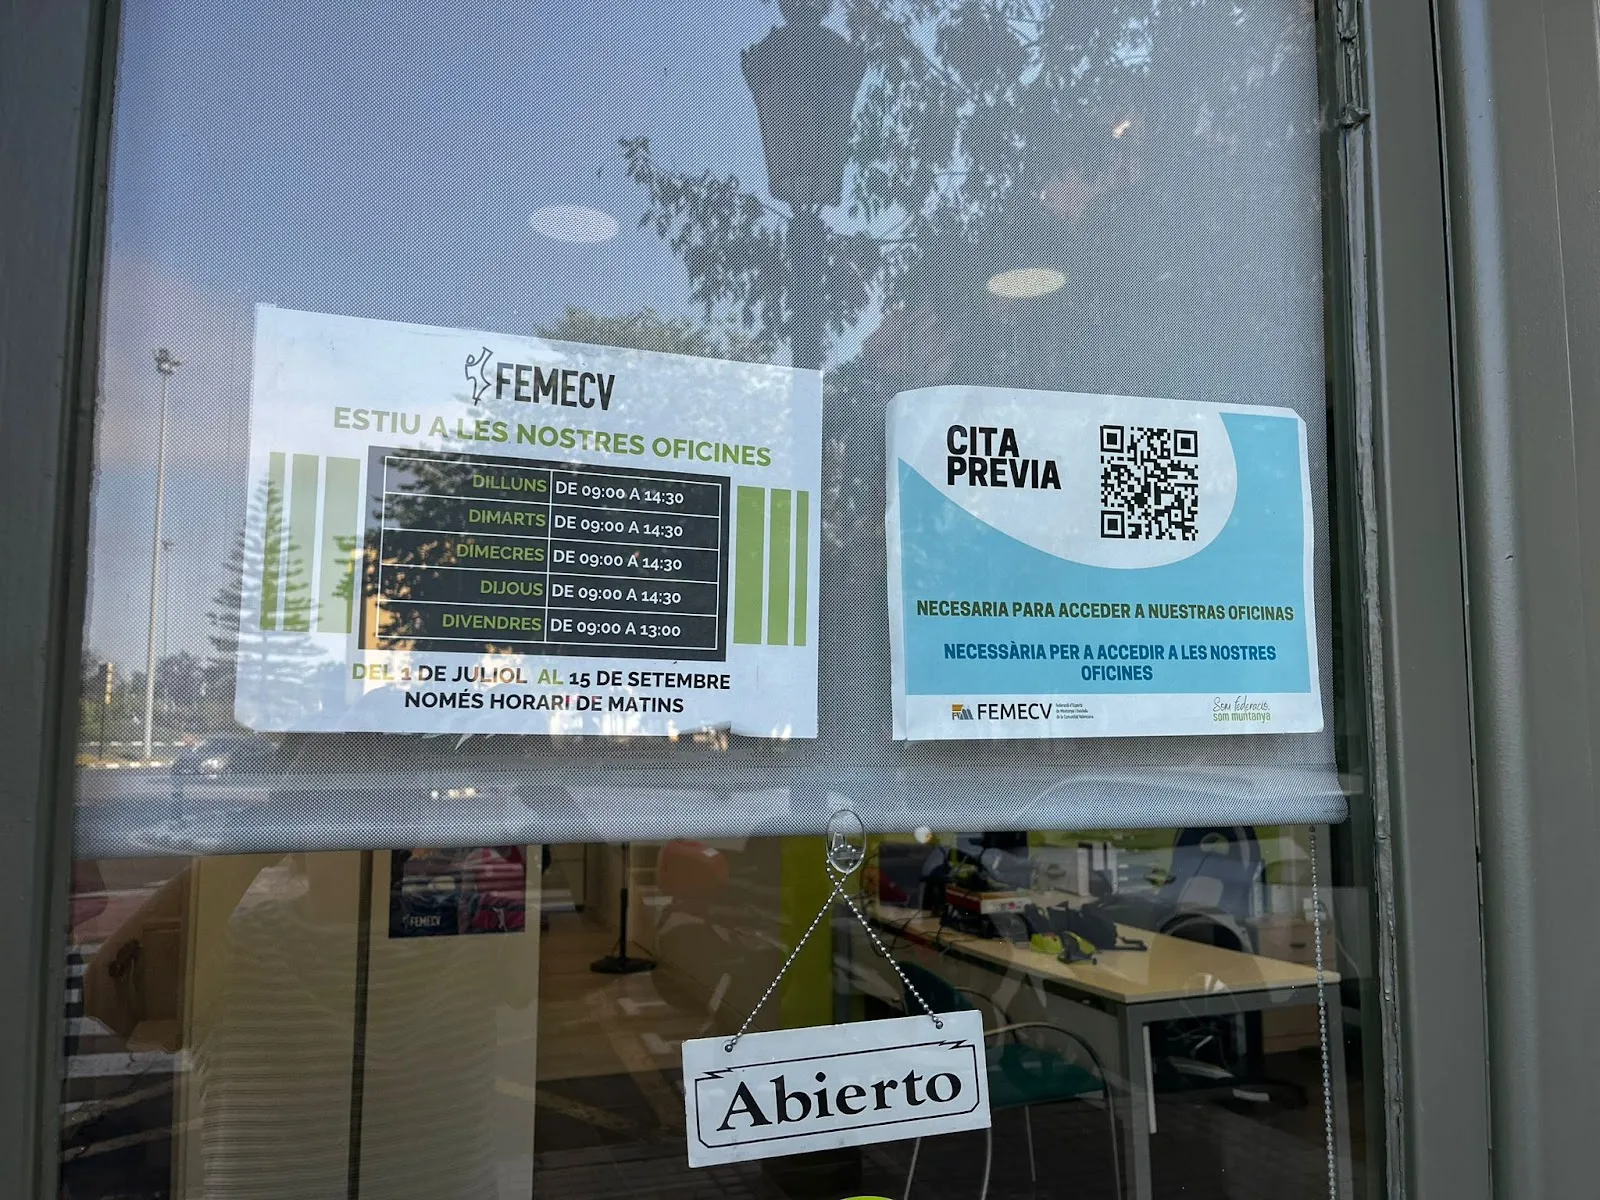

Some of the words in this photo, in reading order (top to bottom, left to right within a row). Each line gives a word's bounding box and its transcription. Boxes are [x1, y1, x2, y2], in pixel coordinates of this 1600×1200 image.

[496, 362, 615, 411] FEMECV
[334, 407, 421, 435] ESTIU
[428, 416, 448, 438] A
[457, 418, 508, 443] LES
[517, 424, 645, 455] NOSTRES
[652, 437, 772, 467] OFICINES
[947, 424, 1020, 457] CITA
[947, 456, 1061, 490] PREVIA
[472, 474, 547, 493] DILLUNS
[555, 481, 578, 496] DE
[581, 485, 625, 500] 09:00
[629, 488, 640, 500] A
[644, 490, 684, 505] 14:30
[468, 509, 546, 527] DIMARTS
[554, 515, 577, 529] DE
[580, 519, 624, 533] 09:00
[628, 521, 640, 534] A
[643, 524, 683, 538] 14:30
[456, 544, 545, 562] DIMECRES
[553, 549, 576, 564] DE
[579, 553, 623, 567] 09:00
[627, 555, 638, 567] A
[642, 558, 682, 572] 14:30
[480, 580, 544, 597] DIJOUS
[552, 584, 574, 598] DE
[578, 587, 622, 601] 09:00
[626, 588, 637, 601] A
[641, 591, 682, 605] 14:30
[917, 600, 1009, 617] NECESARIA
[1012, 602, 1055, 618] PARA
[1058, 602, 1131, 618] ACCEDER
[1134, 603, 1145, 619] A
[1149, 604, 1225, 620] NUESTRAS
[1228, 605, 1294, 621] OFICINAS
[442, 613, 542, 631] DIVENDRES
[550, 618, 573, 632] DE
[576, 621, 621, 635] 09:00
[625, 622, 636, 635] A
[640, 624, 681, 638] 13:00
[944, 641, 1047, 660] NECESSÀRIA
[1050, 644, 1080, 660] PER
[1083, 644, 1094, 660] A
[1097, 644, 1165, 660] ACCEDIR
[1168, 645, 1178, 660] A
[1181, 645, 1208, 660] LES
[1210, 645, 1277, 661] NOSTRES
[352, 663, 395, 681] DEL
[401, 665, 412, 681] 1
[418, 665, 447, 682] DE
[452, 666, 528, 684] JULIOL
[537, 669, 564, 685] AL
[569, 672, 590, 688] 15
[596, 671, 622, 686] DE
[628, 672, 731, 690] SETEMBRE
[1081, 665, 1153, 681] OFICINES
[405, 689, 483, 709] NOMÉS
[490, 693, 570, 711] HORARI
[576, 696, 602, 711] DE
[608, 697, 684, 713] MATINS
[977, 703, 1052, 720] FEMECV
[1213, 713, 1229, 721] som
[1231, 712, 1271, 723] muntanya
[716, 1069, 962, 1132] Abierto
